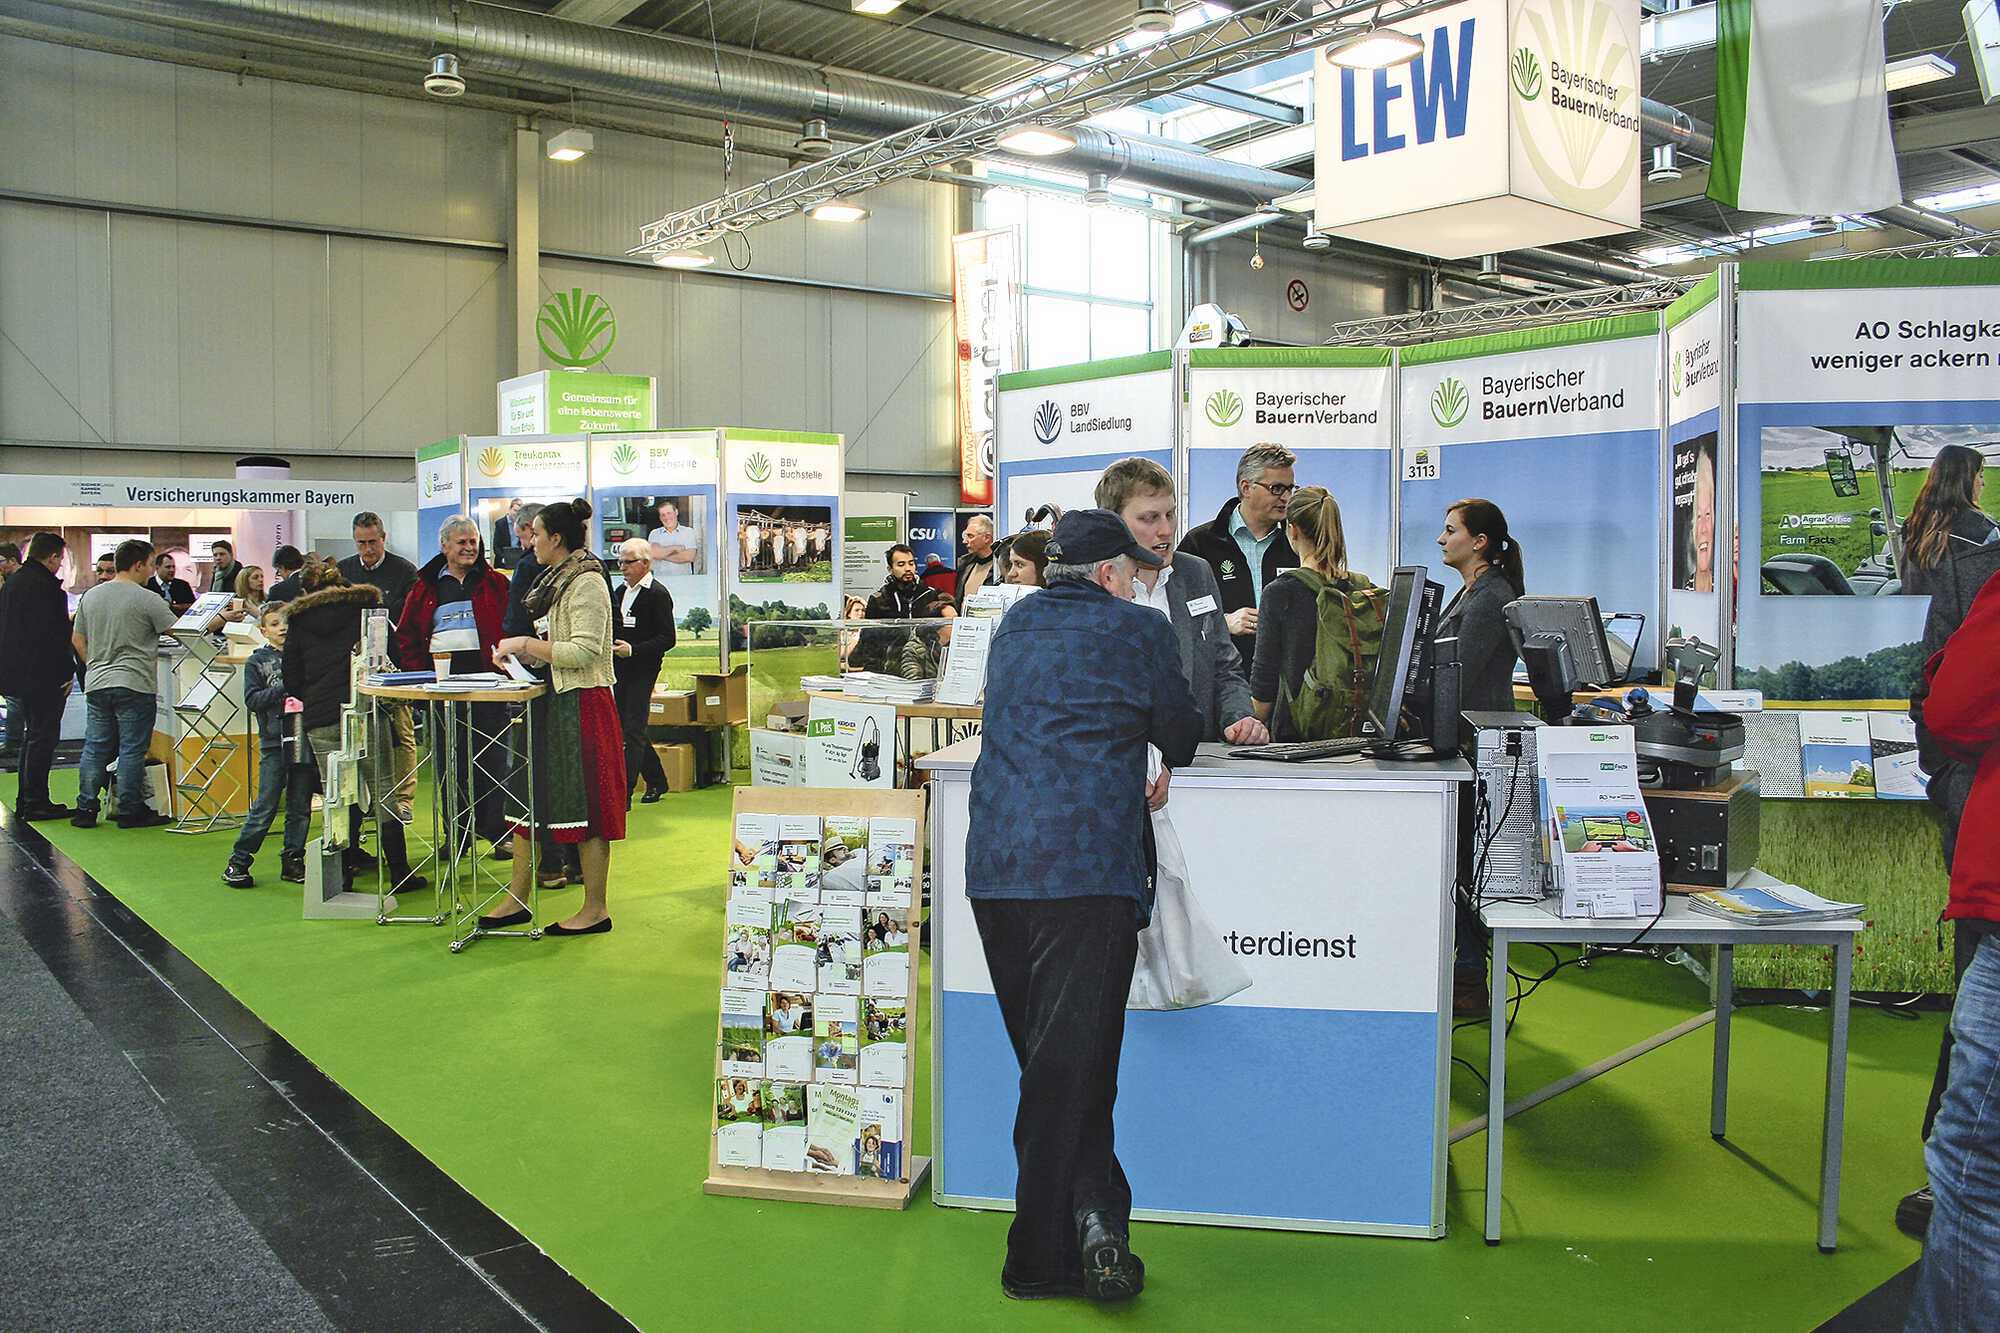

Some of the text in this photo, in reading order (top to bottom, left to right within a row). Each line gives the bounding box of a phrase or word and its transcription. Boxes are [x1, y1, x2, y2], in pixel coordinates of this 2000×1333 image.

[1551, 61, 1617, 100] Bayerischer
[1341, 18, 1475, 161] LEW
[1551, 86, 1639, 132] BauernVerband
[1855, 321, 1890, 339] AO
[1811, 350, 1903, 373] weniger
[1910, 349, 1990, 367] ackern
[1482, 368, 1585, 398] Bayerischer
[562, 392, 638, 405] Gemeinsam für
[1255, 391, 1346, 409] Bayerischer
[1482, 388, 1625, 420] BauernVerband
[558, 406, 642, 419] eine lebenswerte
[1071, 403, 1090, 417] BBV
[1255, 410, 1377, 424] BauernVerband
[1071, 417, 1132, 433] LandSiedlung
[780, 457, 798, 467] BBV
[780, 469, 823, 480] Buchstelle
[1408, 465, 1435, 478] 3113
[127, 486, 355, 506] Versicherungskammer Bayern
[909, 528, 936, 540] CSU
[1780, 534, 1836, 545] Farm Facts
[1223, 930, 1357, 959] terdienst
